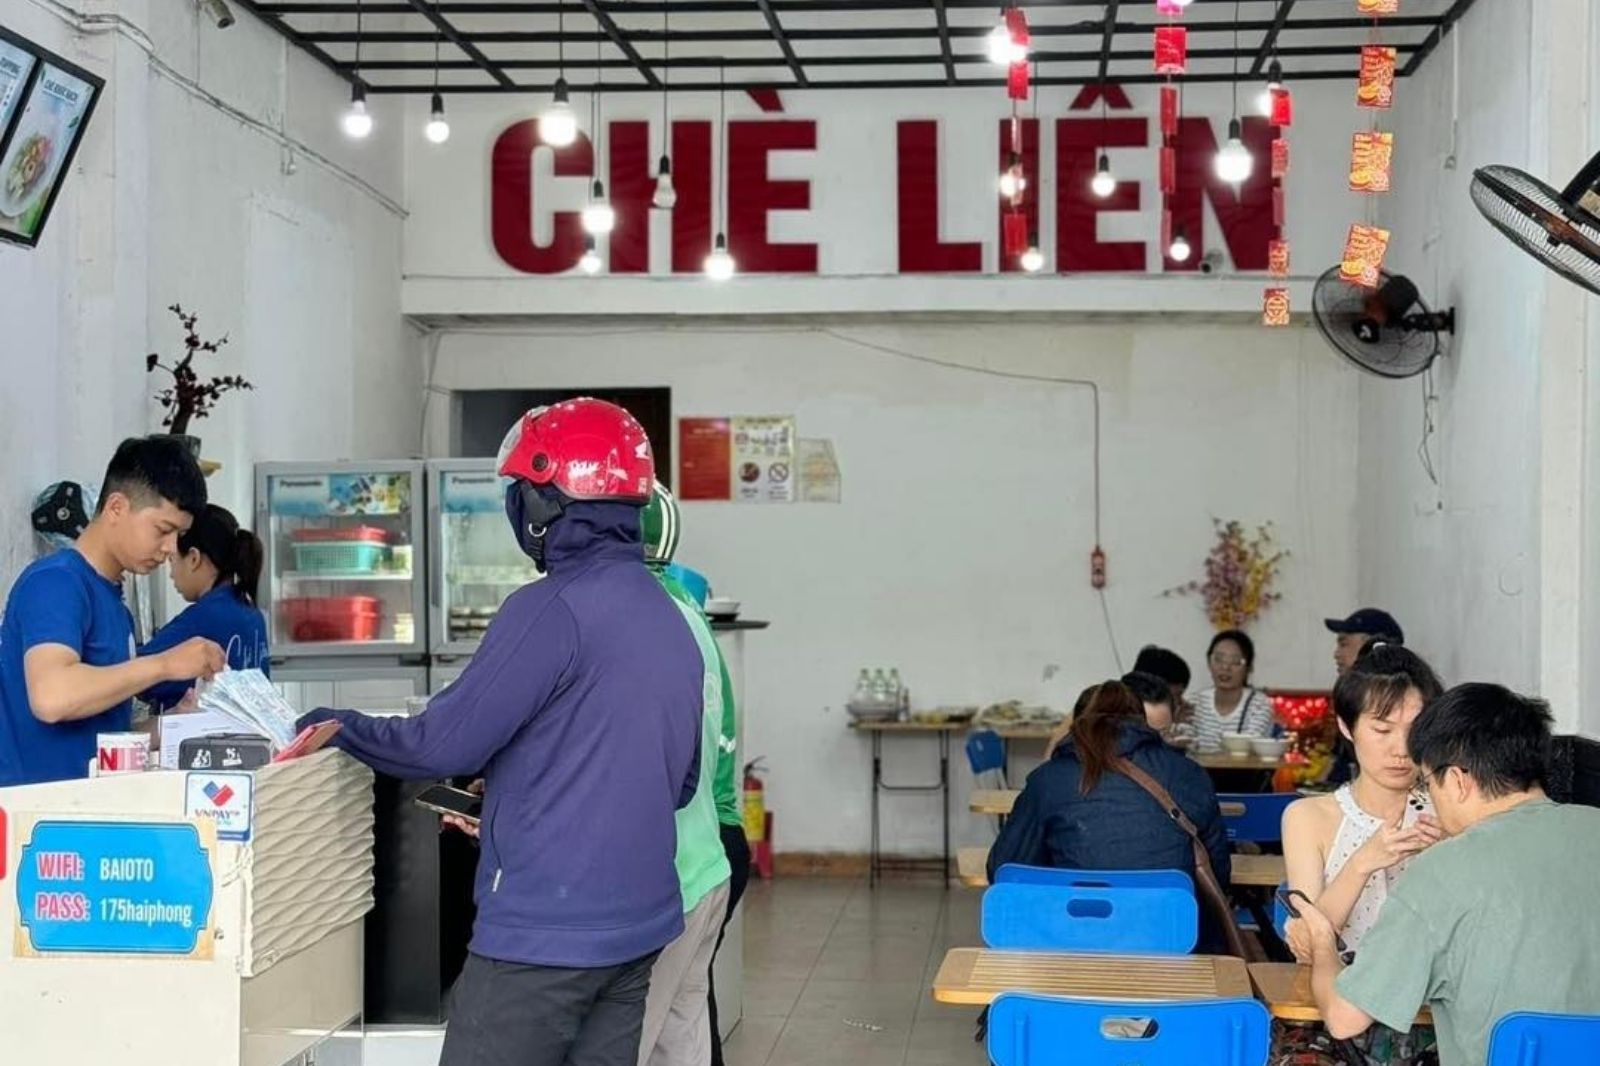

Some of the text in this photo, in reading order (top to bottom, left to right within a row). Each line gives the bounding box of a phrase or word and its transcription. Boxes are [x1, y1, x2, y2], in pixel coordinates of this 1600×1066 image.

[491, 83, 1280, 275] CHÈ LIÊN
[36, 852, 154, 882] WIFI: BAIOTO
[36, 892, 193, 927] PASS: 175haiphong
